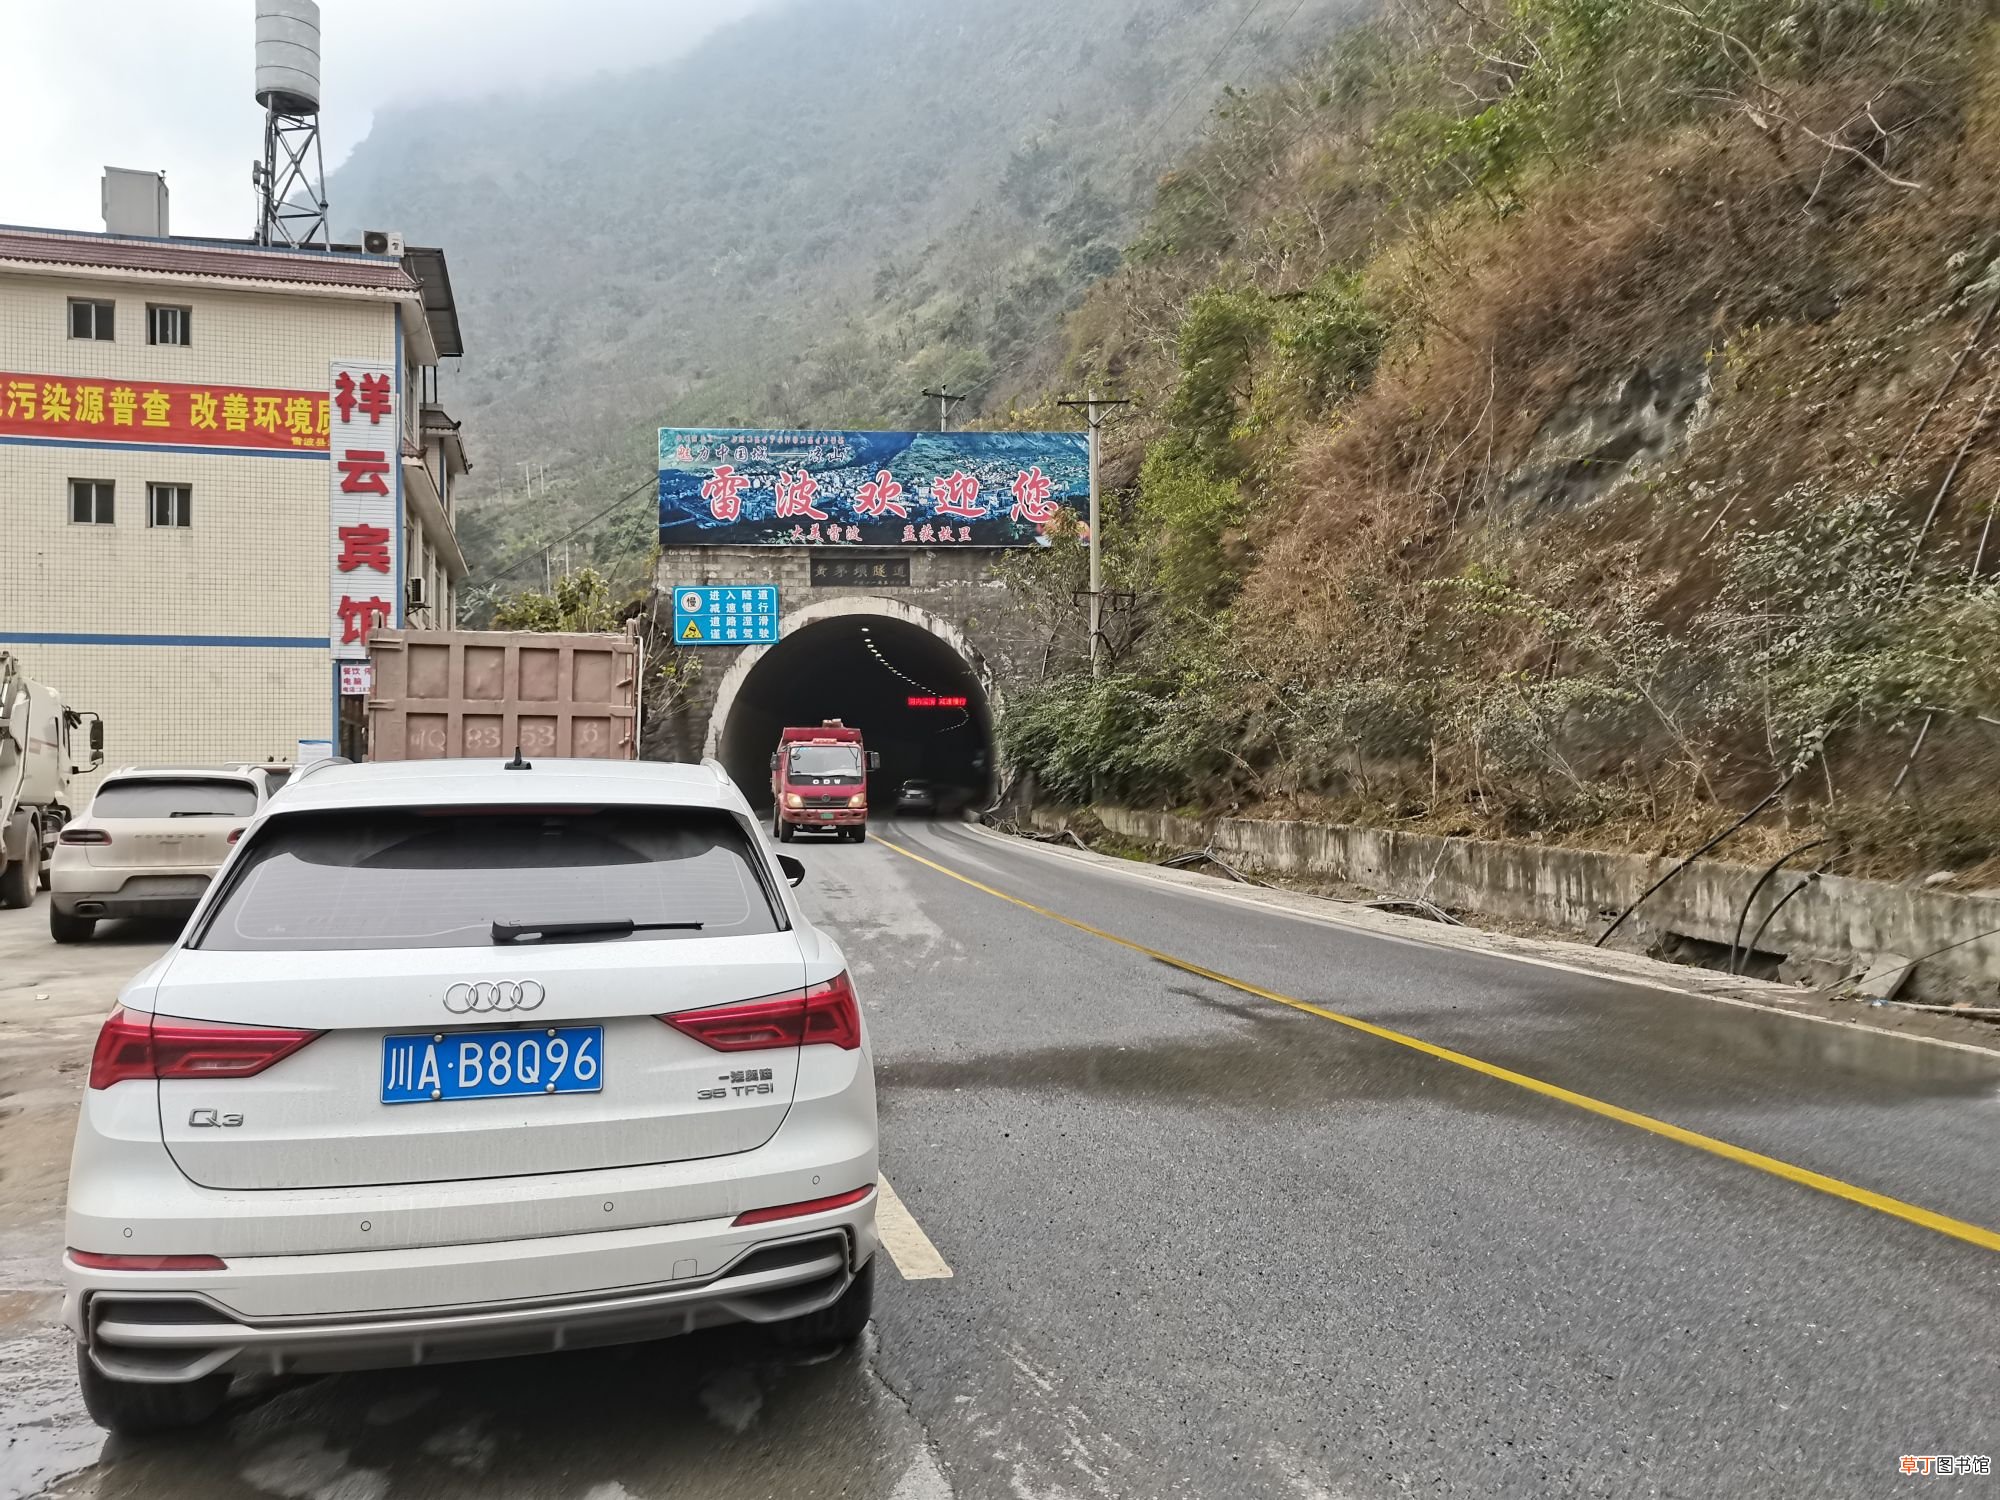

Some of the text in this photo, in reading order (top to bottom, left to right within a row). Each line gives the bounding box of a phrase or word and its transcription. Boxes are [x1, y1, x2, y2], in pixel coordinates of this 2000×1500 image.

[0, 380, 171, 427] 污染源普查
[291, 436, 330, 447] 雷波县
[701, 464, 1059, 522] 雷波欢迎您
[335, 371, 392, 646] 祥云宾馆
[790, 523, 863, 542] 大美雷波
[687, 597, 697, 608] 慢
[709, 590, 769, 601] 进入隧道
[709, 602, 769, 613] 减速慢行
[709, 616, 769, 627] 道路湿滑
[710, 628, 770, 640] 谨慎驾驶
[697, 1083, 774, 1100] 35 TFSI
[189, 1108, 244, 1128] Q3
